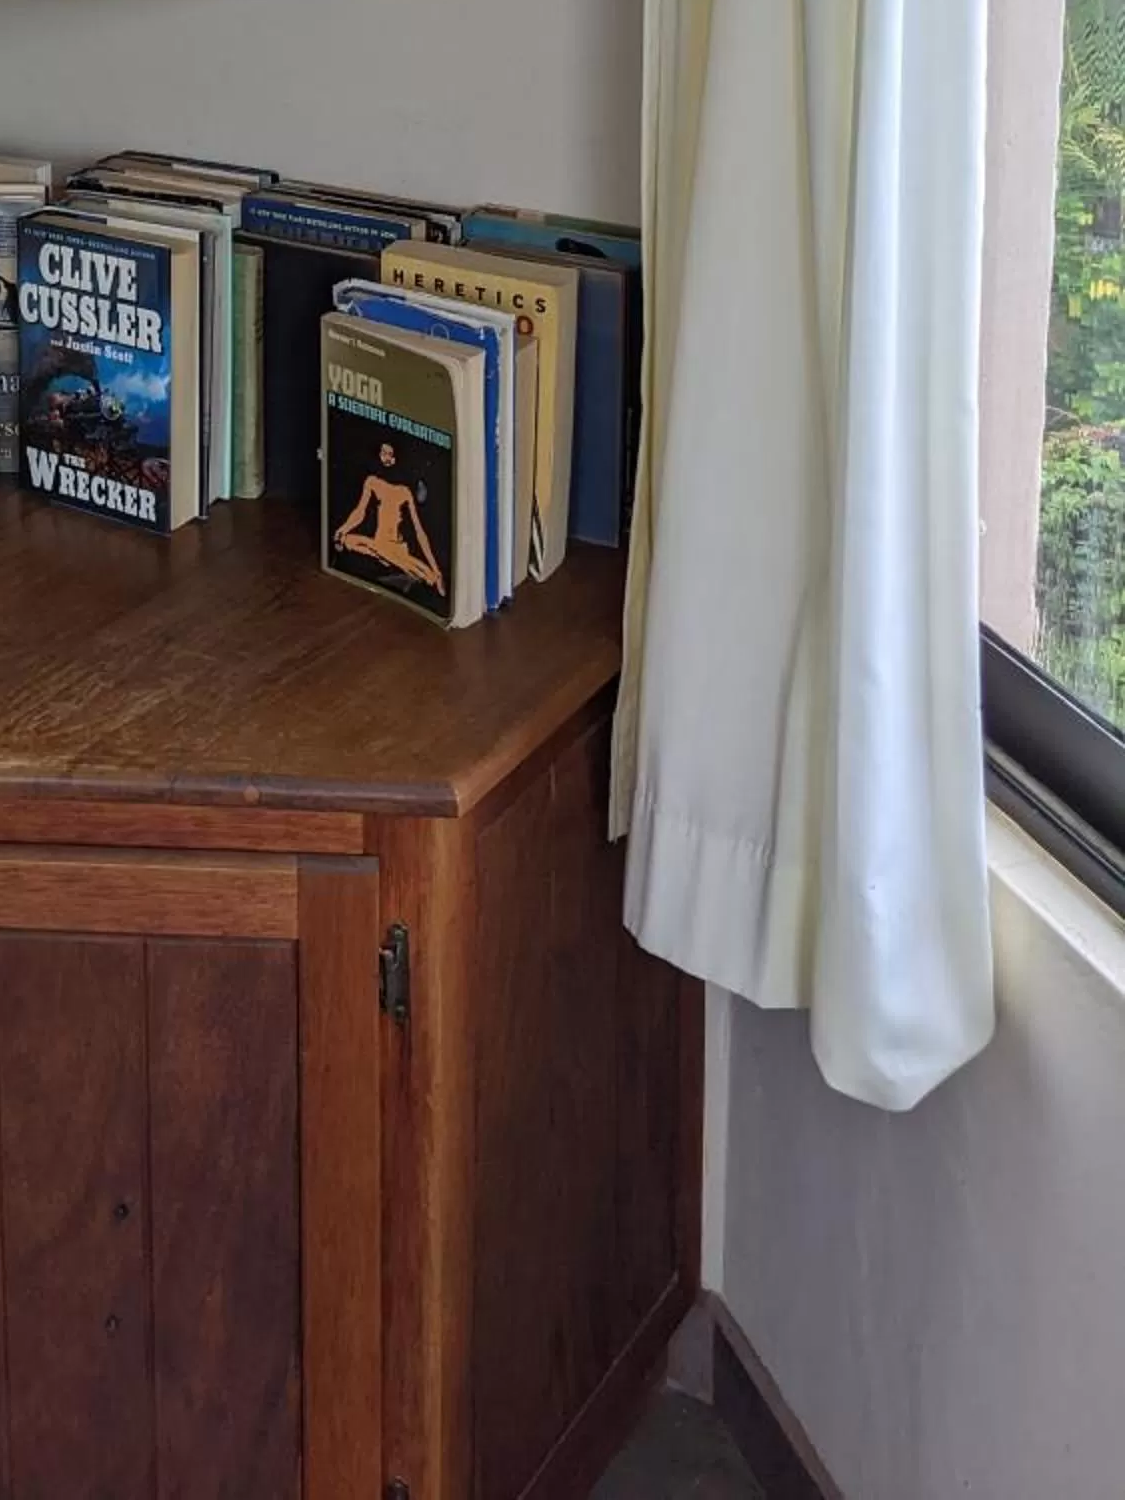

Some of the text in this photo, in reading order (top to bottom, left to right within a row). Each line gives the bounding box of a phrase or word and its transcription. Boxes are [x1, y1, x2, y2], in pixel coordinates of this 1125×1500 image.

[38, 242, 138, 301] CLIVE
[393, 268, 547, 314] HERETICS
[19, 282, 162, 353] CUSSLER
[65, 336, 103, 356] Justin
[104, 345, 135, 365] Scott
[328, 363, 384, 406] YOGA
[26, 445, 156, 522] WRECKER
[62, 452, 86, 469] THE
